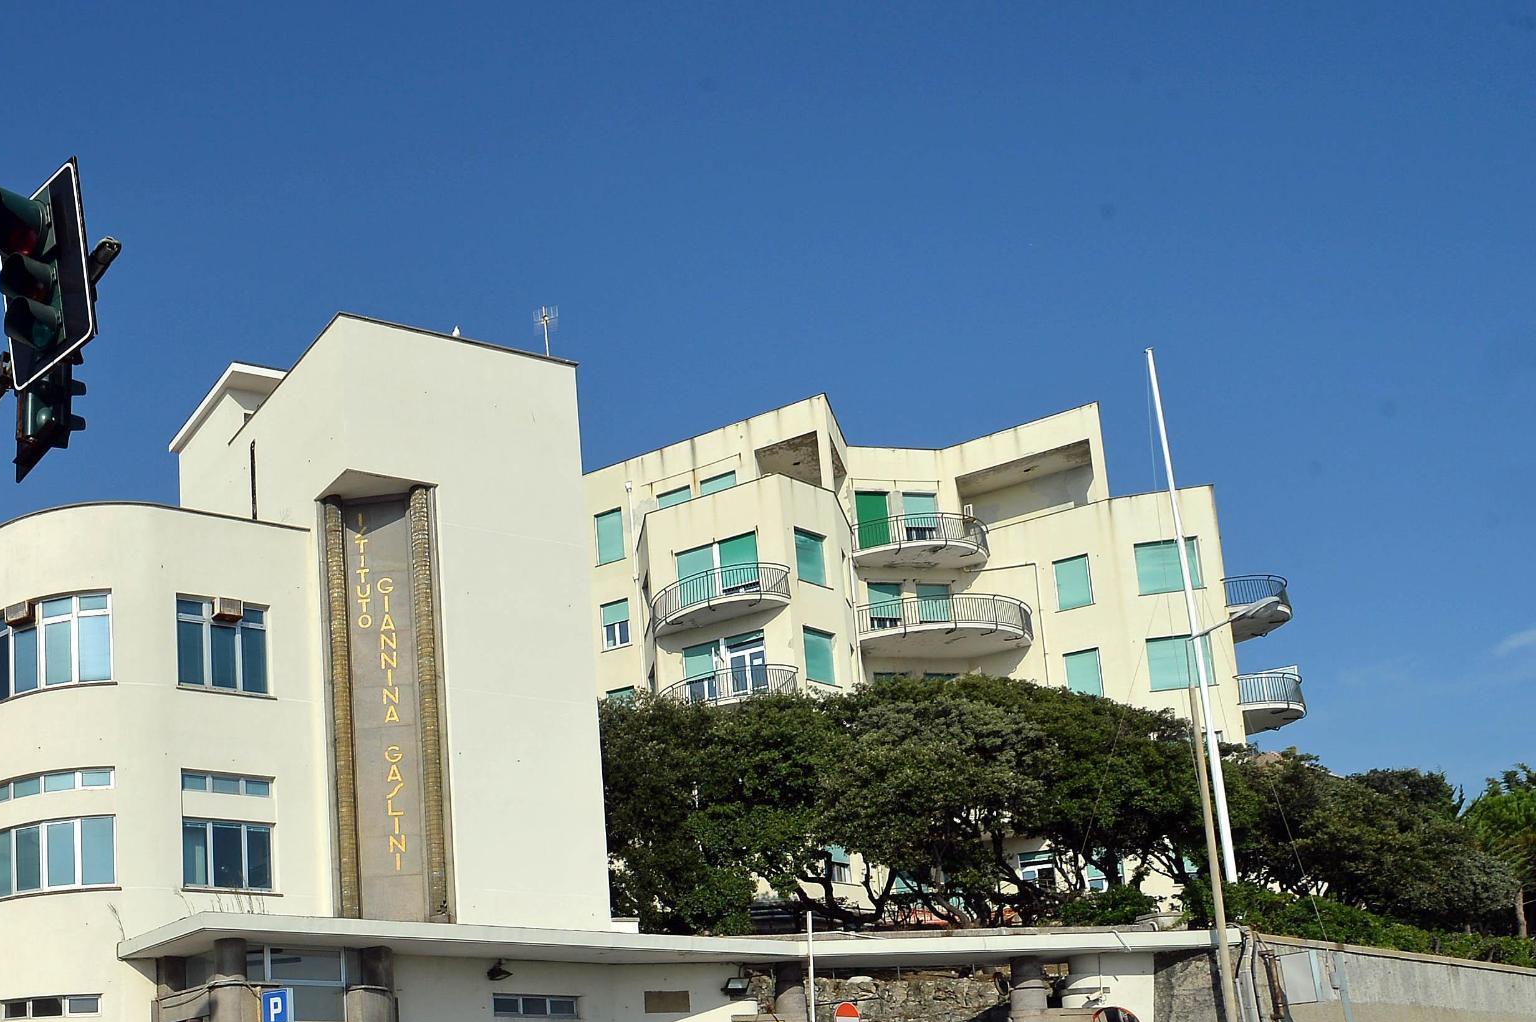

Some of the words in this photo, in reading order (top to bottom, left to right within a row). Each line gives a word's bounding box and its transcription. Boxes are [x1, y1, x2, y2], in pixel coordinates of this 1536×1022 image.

[354, 513, 372, 629] ISTITUTO
[376, 577, 400, 723] GIANNINA
[384, 745, 406, 871] GASLINI
[269, 997, 282, 1022] P
